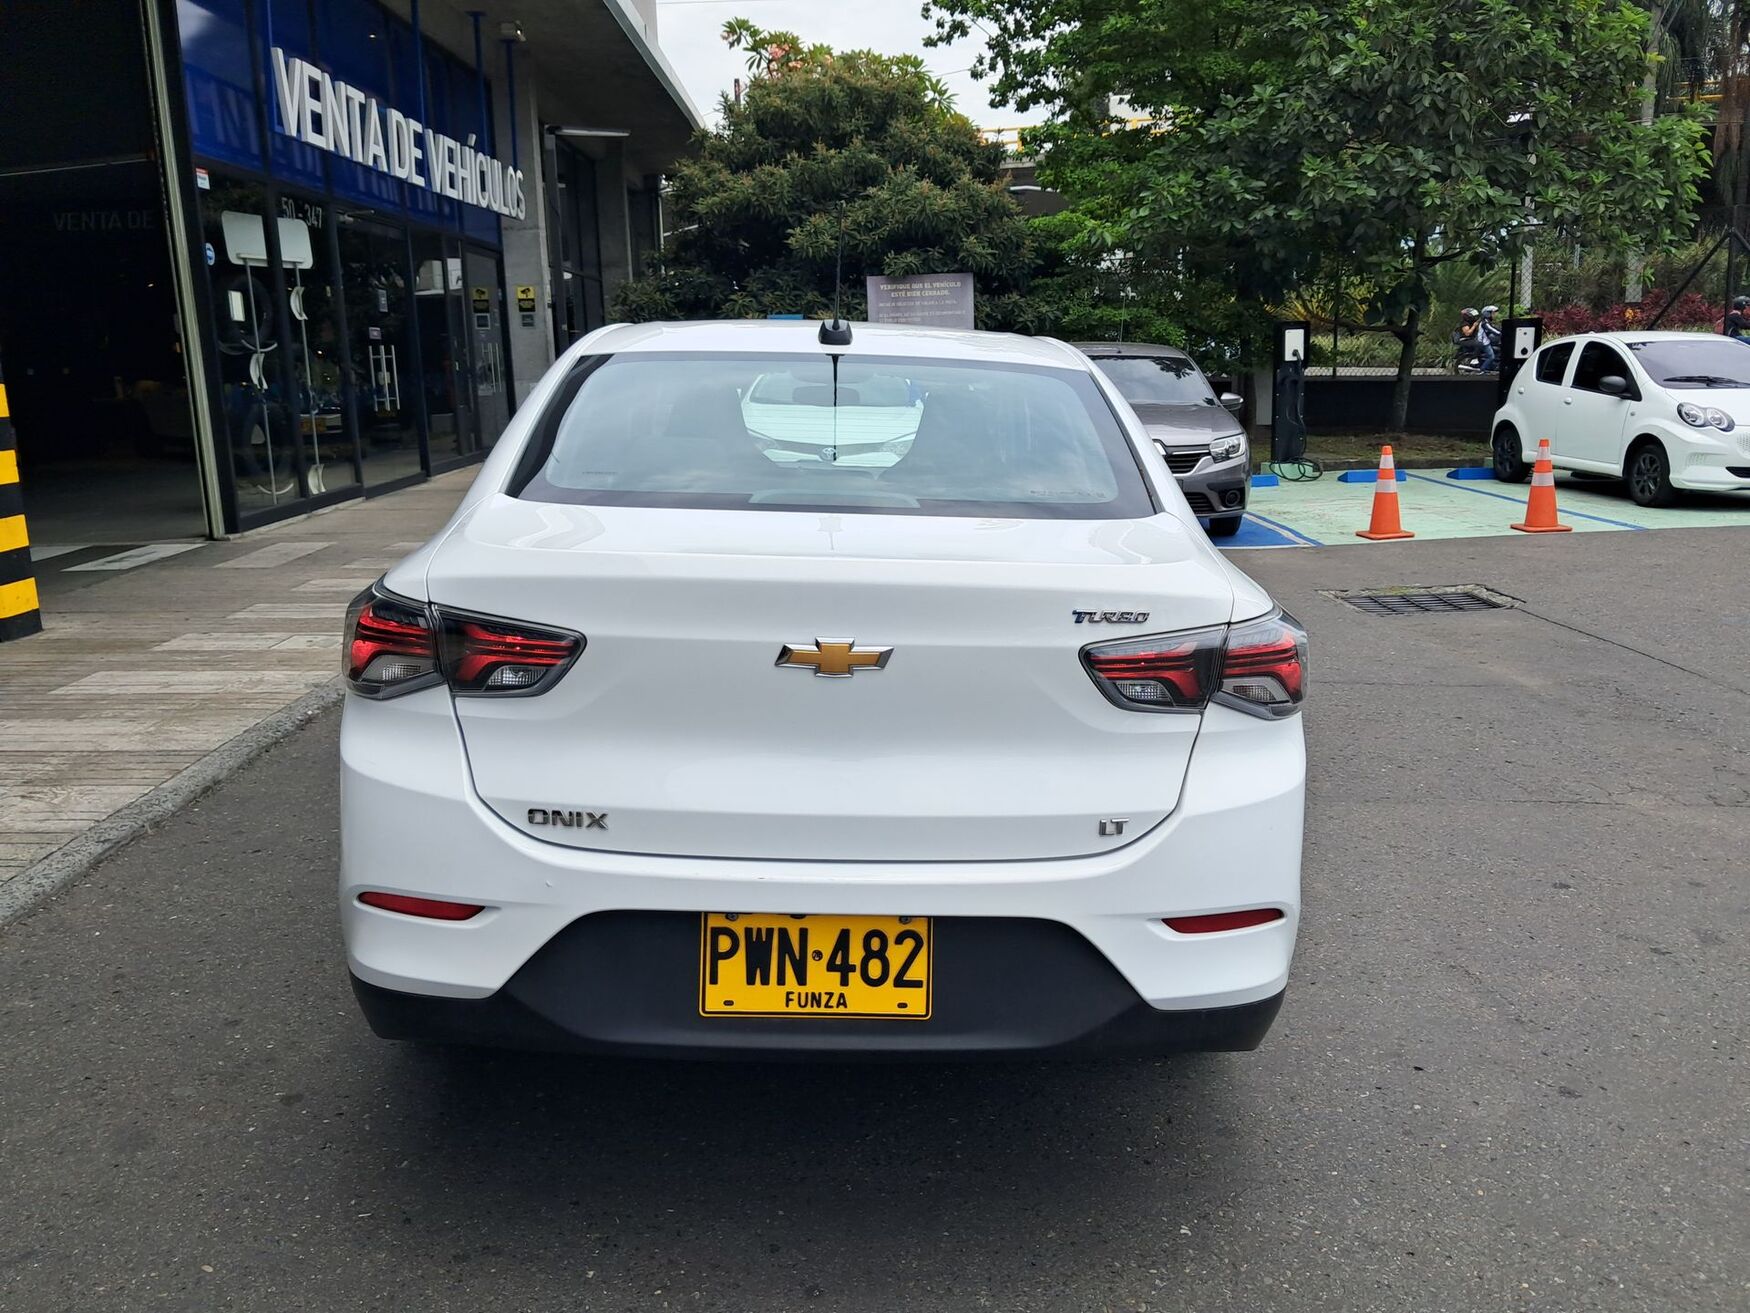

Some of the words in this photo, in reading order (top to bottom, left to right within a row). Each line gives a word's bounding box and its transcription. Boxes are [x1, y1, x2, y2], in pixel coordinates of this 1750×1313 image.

[271, 47, 388, 173] VENTA
[387, 107, 426, 187] DE
[424, 128, 526, 221] VEHÍCULOS
[53, 209, 123, 232] VENTA
[127, 208, 156, 230] DE
[304, 203, 322, 229] 347
[1072, 610, 1150, 624] TURBO
[527, 808, 608, 830] ONIX
[1099, 817, 1130, 836] LT
[785, 991, 848, 1009] FUNZA
